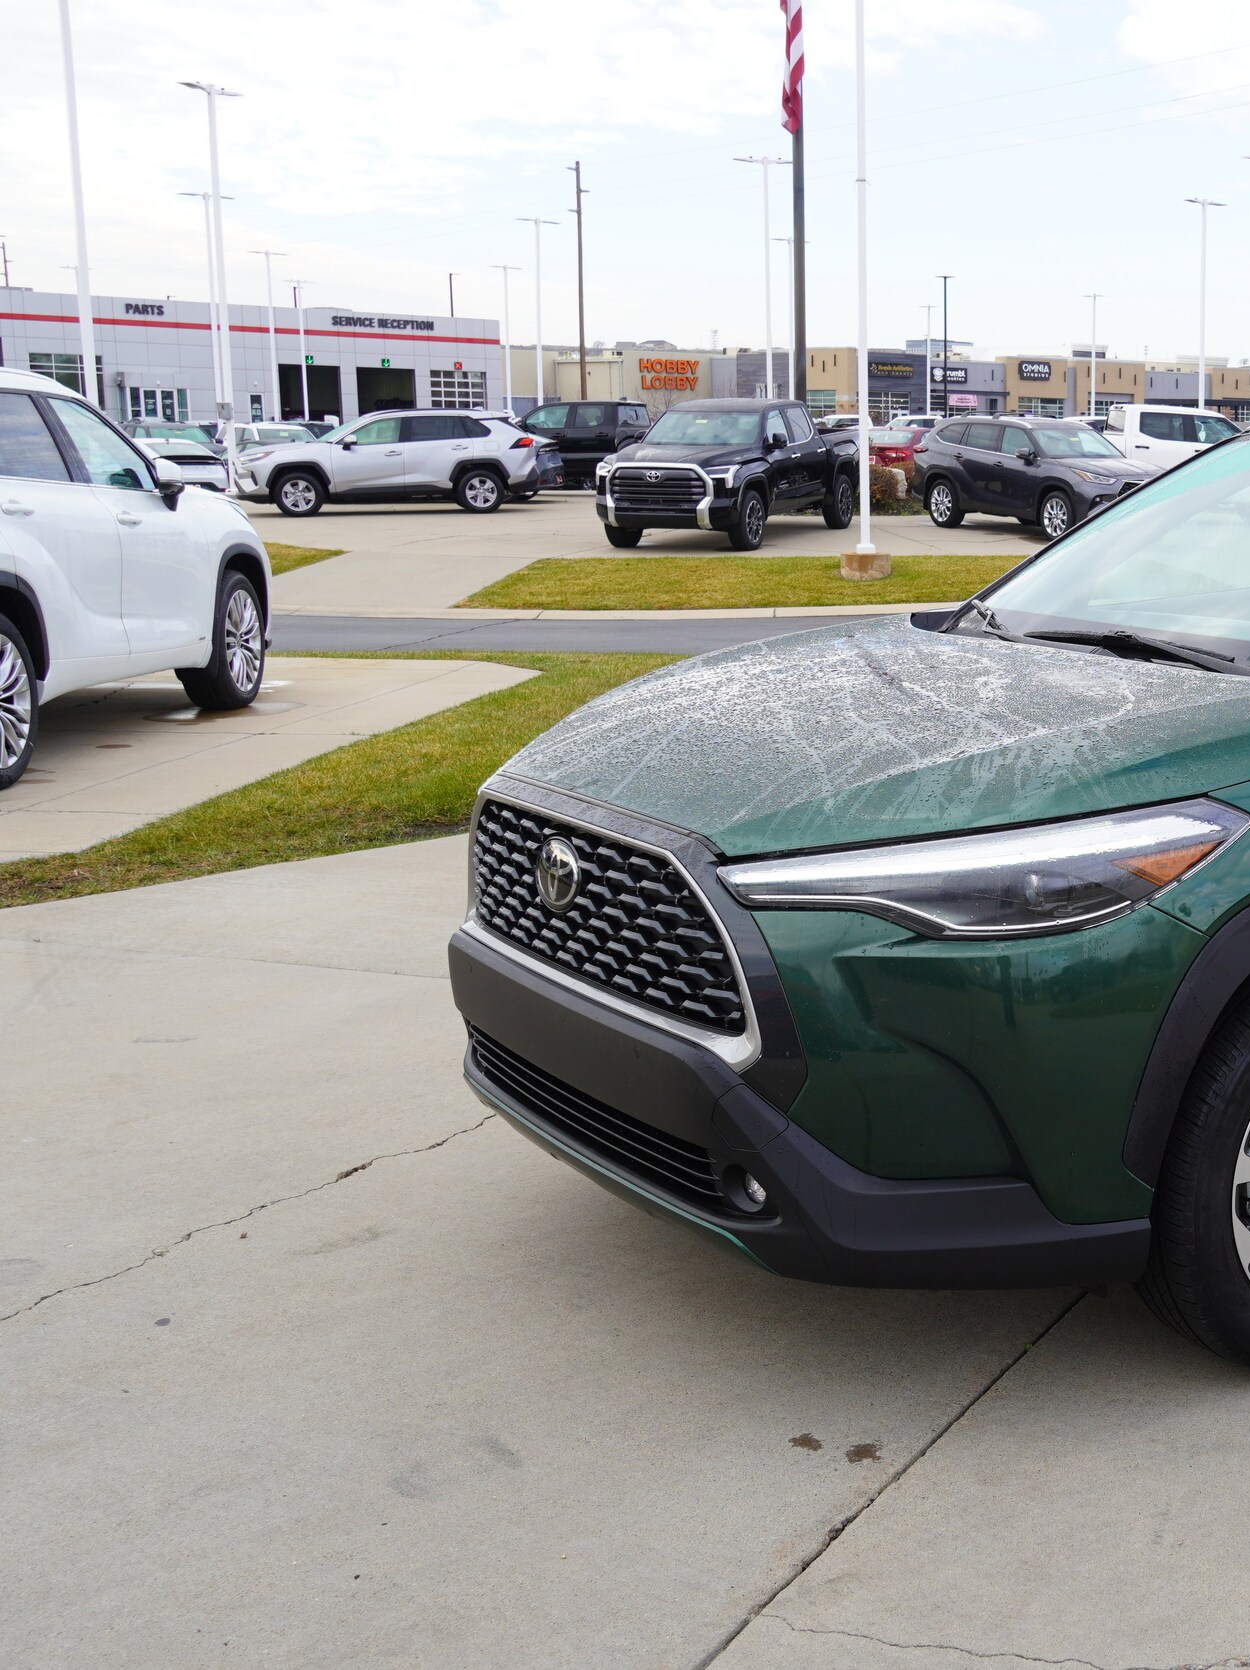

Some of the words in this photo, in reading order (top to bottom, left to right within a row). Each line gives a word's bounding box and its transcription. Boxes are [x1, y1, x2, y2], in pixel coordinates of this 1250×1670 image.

[125, 303, 165, 316] PARTS
[331, 315, 376, 328] SERVICE
[377, 318, 435, 331] RECEPTION
[639, 358, 699, 375] HOBBY
[946, 369, 966, 378] rumbl
[1022, 363, 1050, 373] OMNIA
[641, 375, 698, 391] LOBBY
